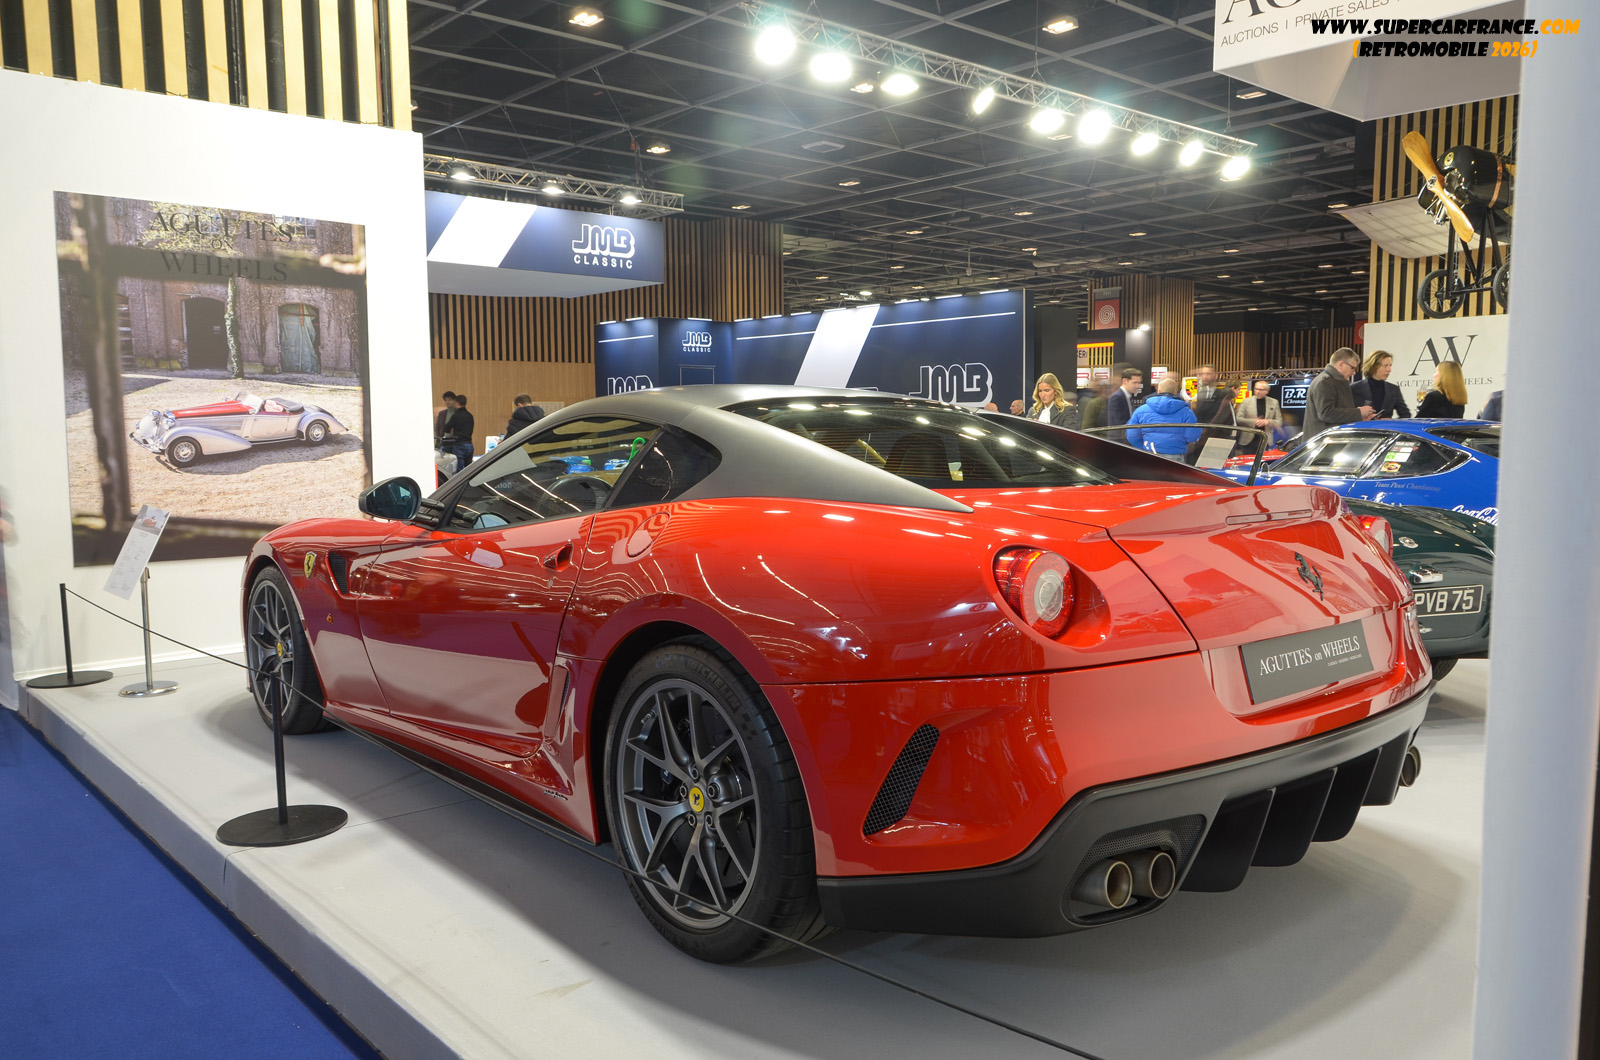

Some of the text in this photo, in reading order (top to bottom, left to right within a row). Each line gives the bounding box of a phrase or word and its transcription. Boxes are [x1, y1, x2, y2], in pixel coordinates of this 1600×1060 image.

[1220, 22, 1279, 47] AUCTIONS
[1295, 5, 1344, 27] PRIVATE
[150, 211, 293, 243] AGUTTES
[572, 223, 635, 258] JMB
[160, 252, 287, 282] WHEELS
[573, 254, 633, 269] CLASSIC
[682, 331, 712, 347] JMB
[908, 363, 993, 408] JMB
[1415, 589, 1475, 612] PVB 75
[1260, 647, 1313, 675] AGUTTES
[1314, 652, 1323, 661] on
[1321, 636, 1360, 658] WHEELS
